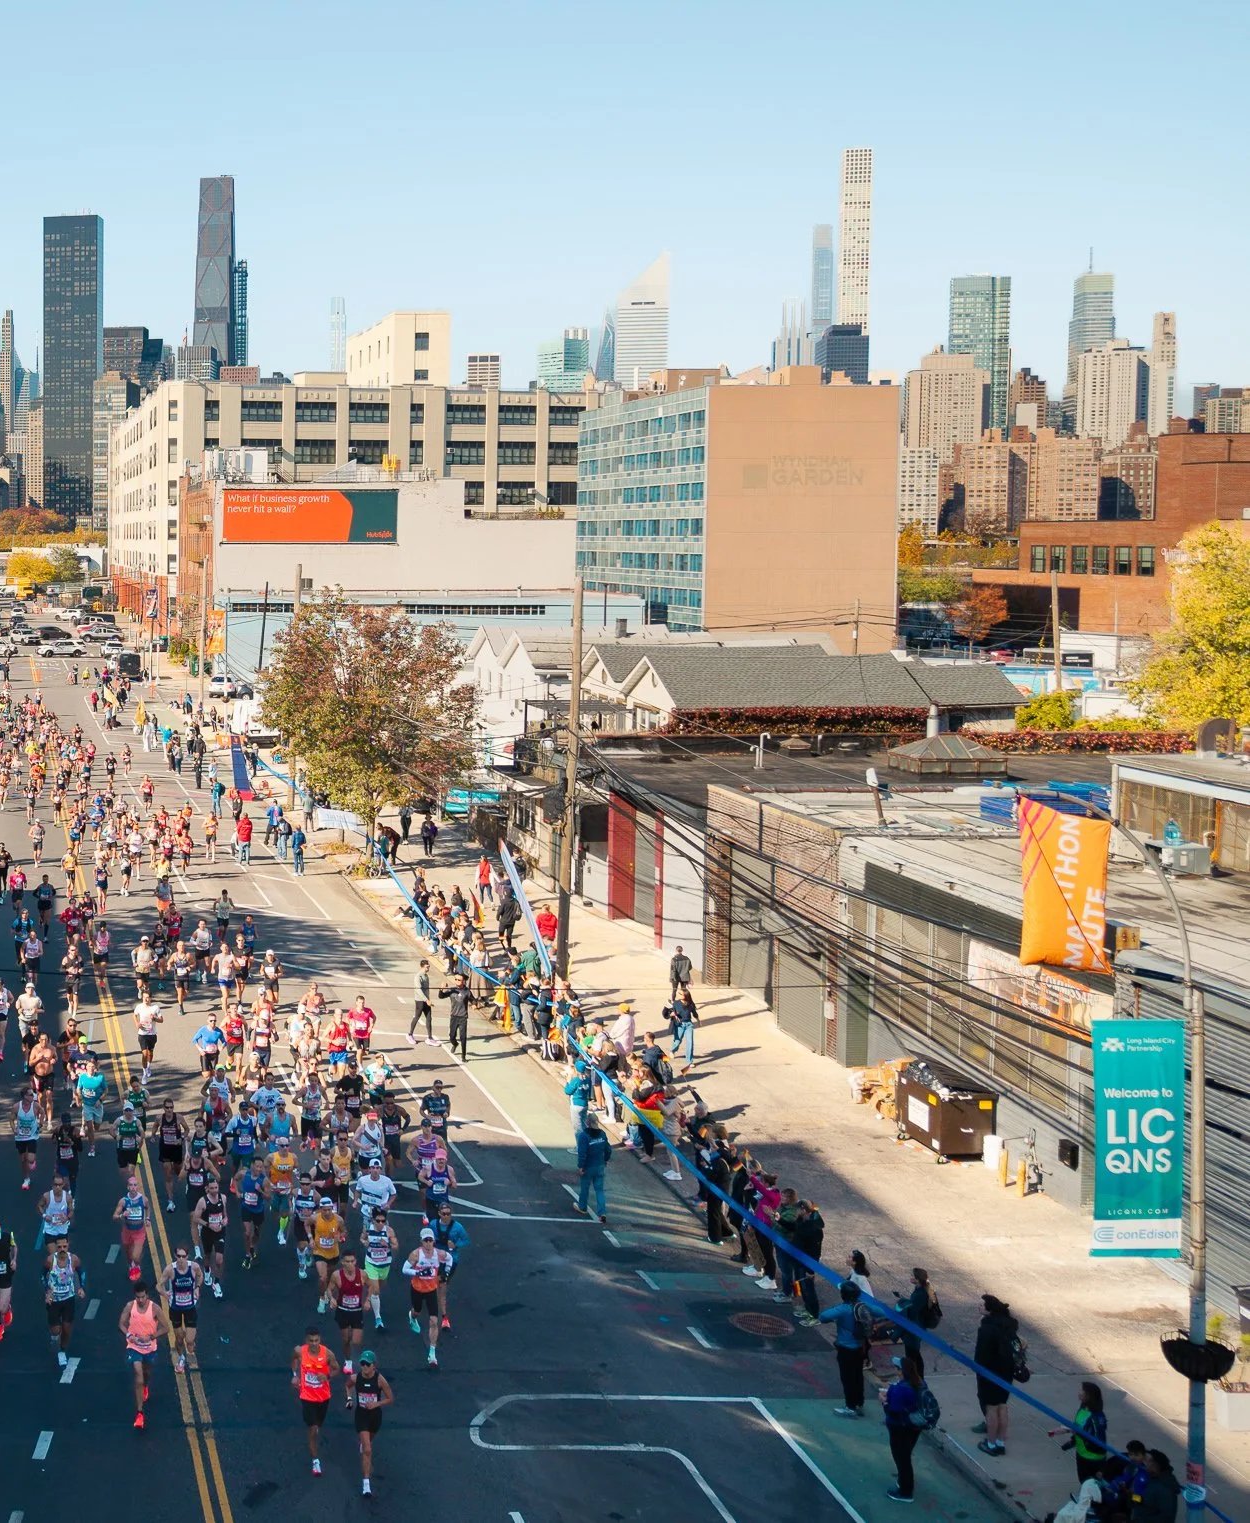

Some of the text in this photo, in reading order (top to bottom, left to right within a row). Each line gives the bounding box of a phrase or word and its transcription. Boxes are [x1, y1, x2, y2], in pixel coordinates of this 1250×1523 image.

[772, 468, 864, 486] GARDEN
[227, 494, 330, 505] What if business growth
[227, 505, 251, 513] never
[253, 505, 265, 513] hit
[274, 505, 297, 513] wall?
[1126, 1037, 1143, 1045] Long
[1162, 1037, 1176, 1045] City
[1103, 1087, 1174, 1099] Welcome to
[1106, 1107, 1176, 1145] LIC
[1104, 1147, 1173, 1175] QNS
[1107, 1208, 1170, 1216] LICQNS.COM
[1116, 1228, 1179, 1240] conEdison
